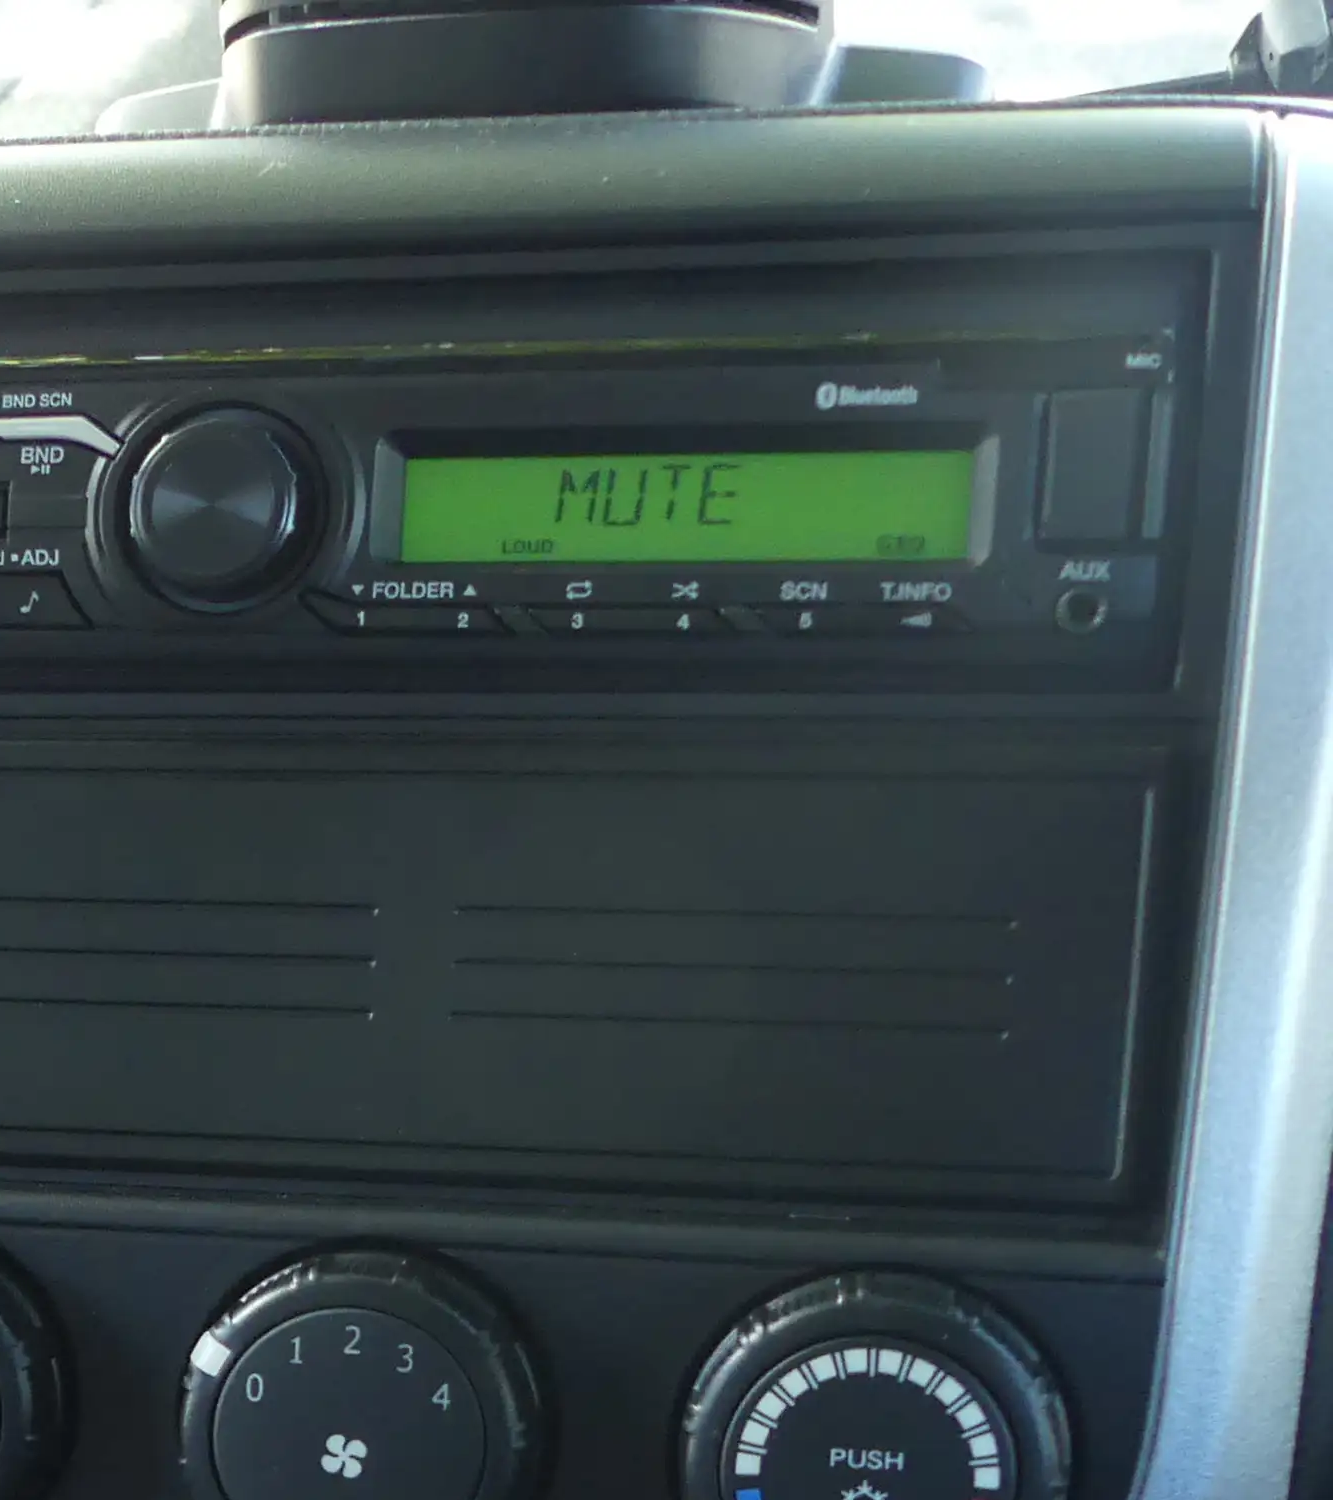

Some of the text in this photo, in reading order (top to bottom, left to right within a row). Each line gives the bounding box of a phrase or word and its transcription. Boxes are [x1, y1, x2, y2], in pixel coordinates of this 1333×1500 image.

[1, 392, 73, 409] BND SCN
[20, 447, 65, 465] BND
[554, 462, 741, 526] MUTE
[501, 538, 555, 555] LOUD
[20, 549, 60, 567] ADJ
[1058, 560, 1112, 582] AUX
[371, 581, 454, 599] FOLDER
[779, 580, 829, 601] SCN
[356, 611, 366, 627] 1
[457, 612, 470, 628] 2
[570, 612, 584, 629] 3
[676, 613, 691, 629] 4
[245, 1325, 452, 1411] 0 1 2 3 4
[829, 1447, 905, 1471] PUSH
